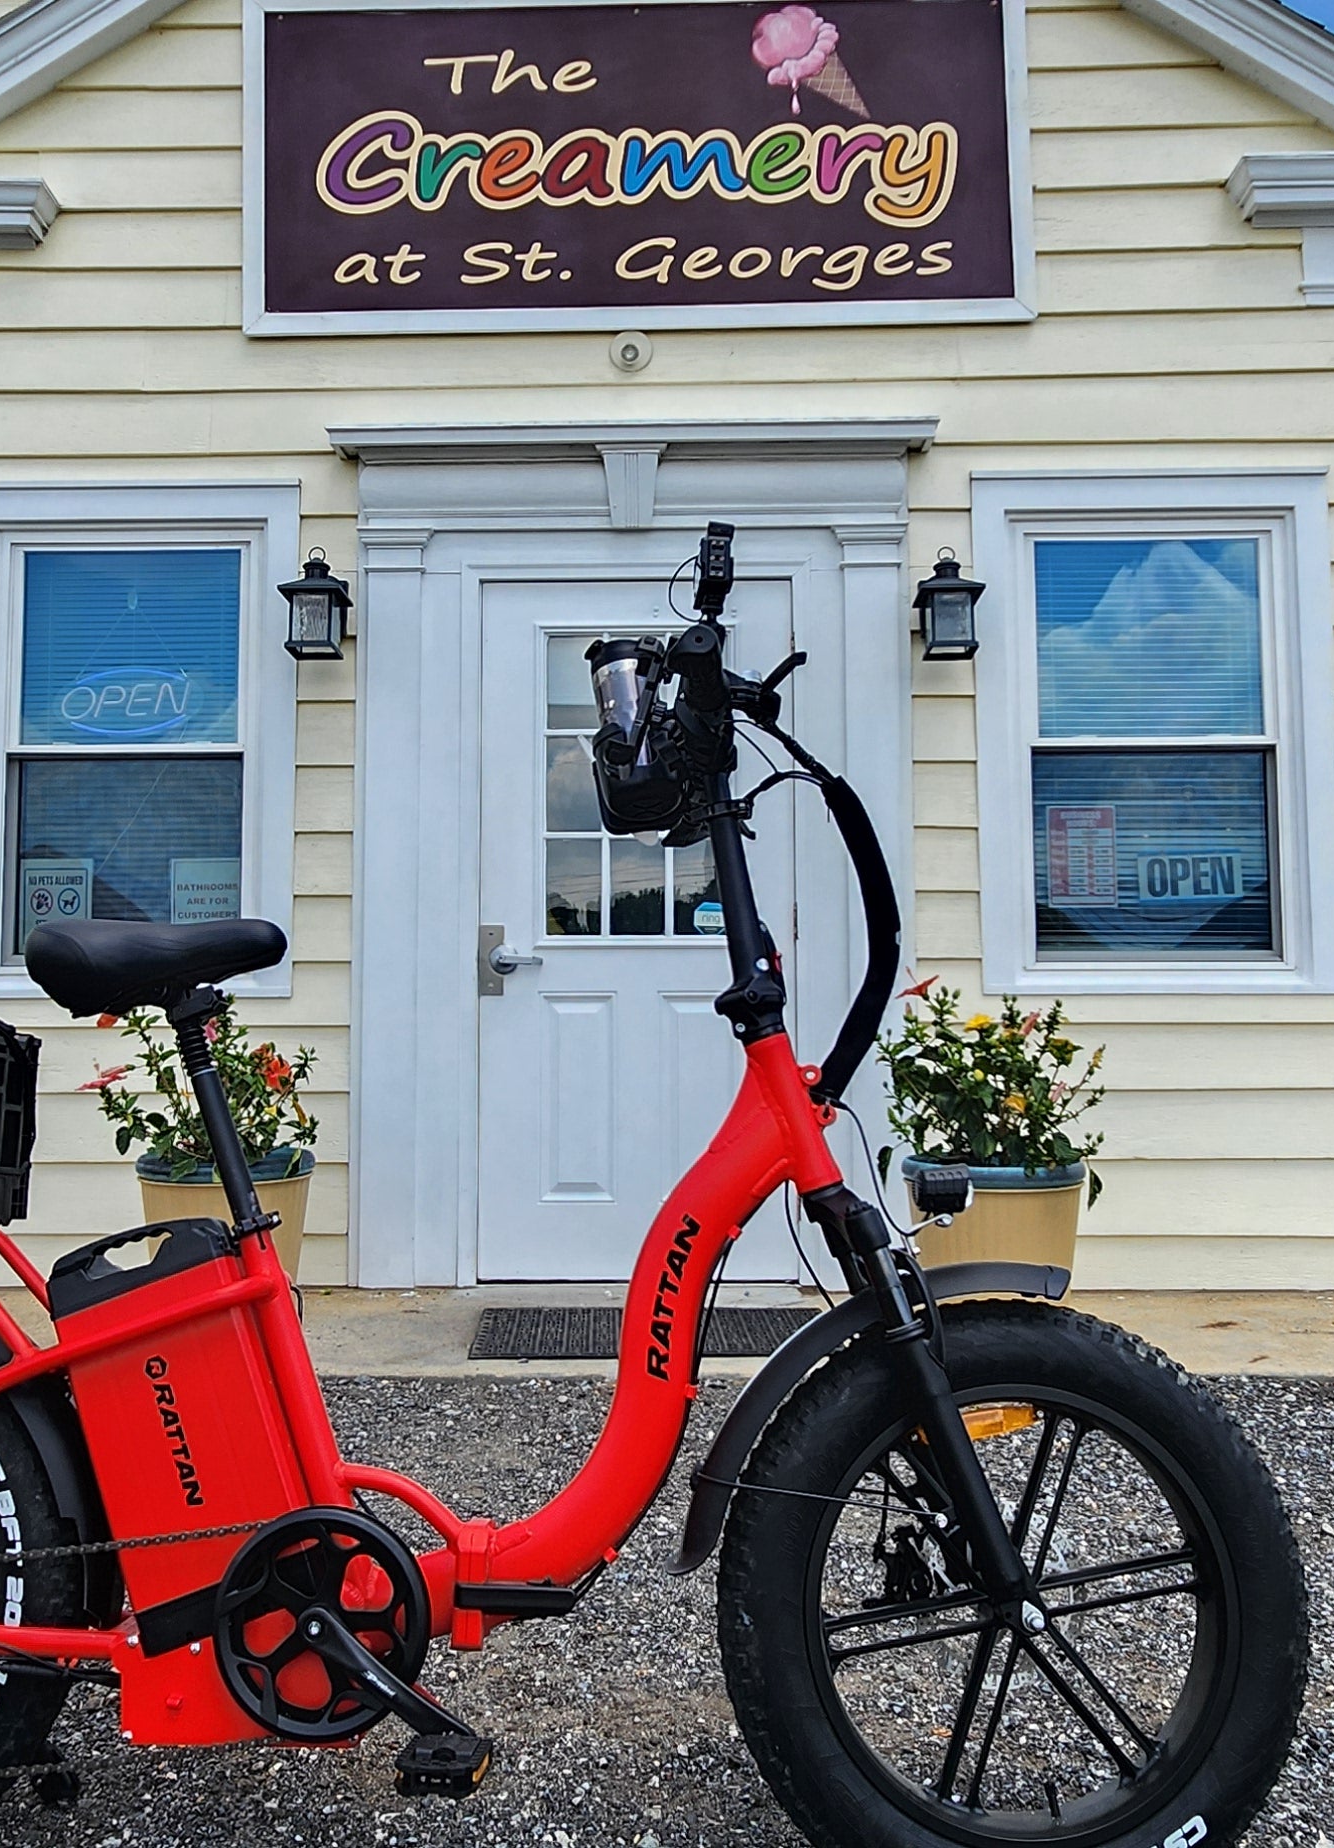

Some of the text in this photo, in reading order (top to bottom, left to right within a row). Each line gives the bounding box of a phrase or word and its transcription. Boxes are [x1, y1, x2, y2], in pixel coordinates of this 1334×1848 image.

[424, 50, 597, 95] The
[318, 112, 957, 227] Creamery
[334, 236, 953, 291] at St. Georges
[61, 681, 190, 719] OPEN
[28, 875, 83, 886] NO PETS ALLOWED
[177, 883, 238, 892] BATHROOMS
[1147, 856, 1235, 897] OPEN
[177, 910, 238, 920] CUSTOMERS
[187, 897, 229, 905] ARE FOR
[646, 1213, 702, 1382] RATTAN
[152, 1383, 205, 1506] RATTAN
[3, 1575, 25, 1628] 20
[1151, 1815, 1208, 1848] CS
